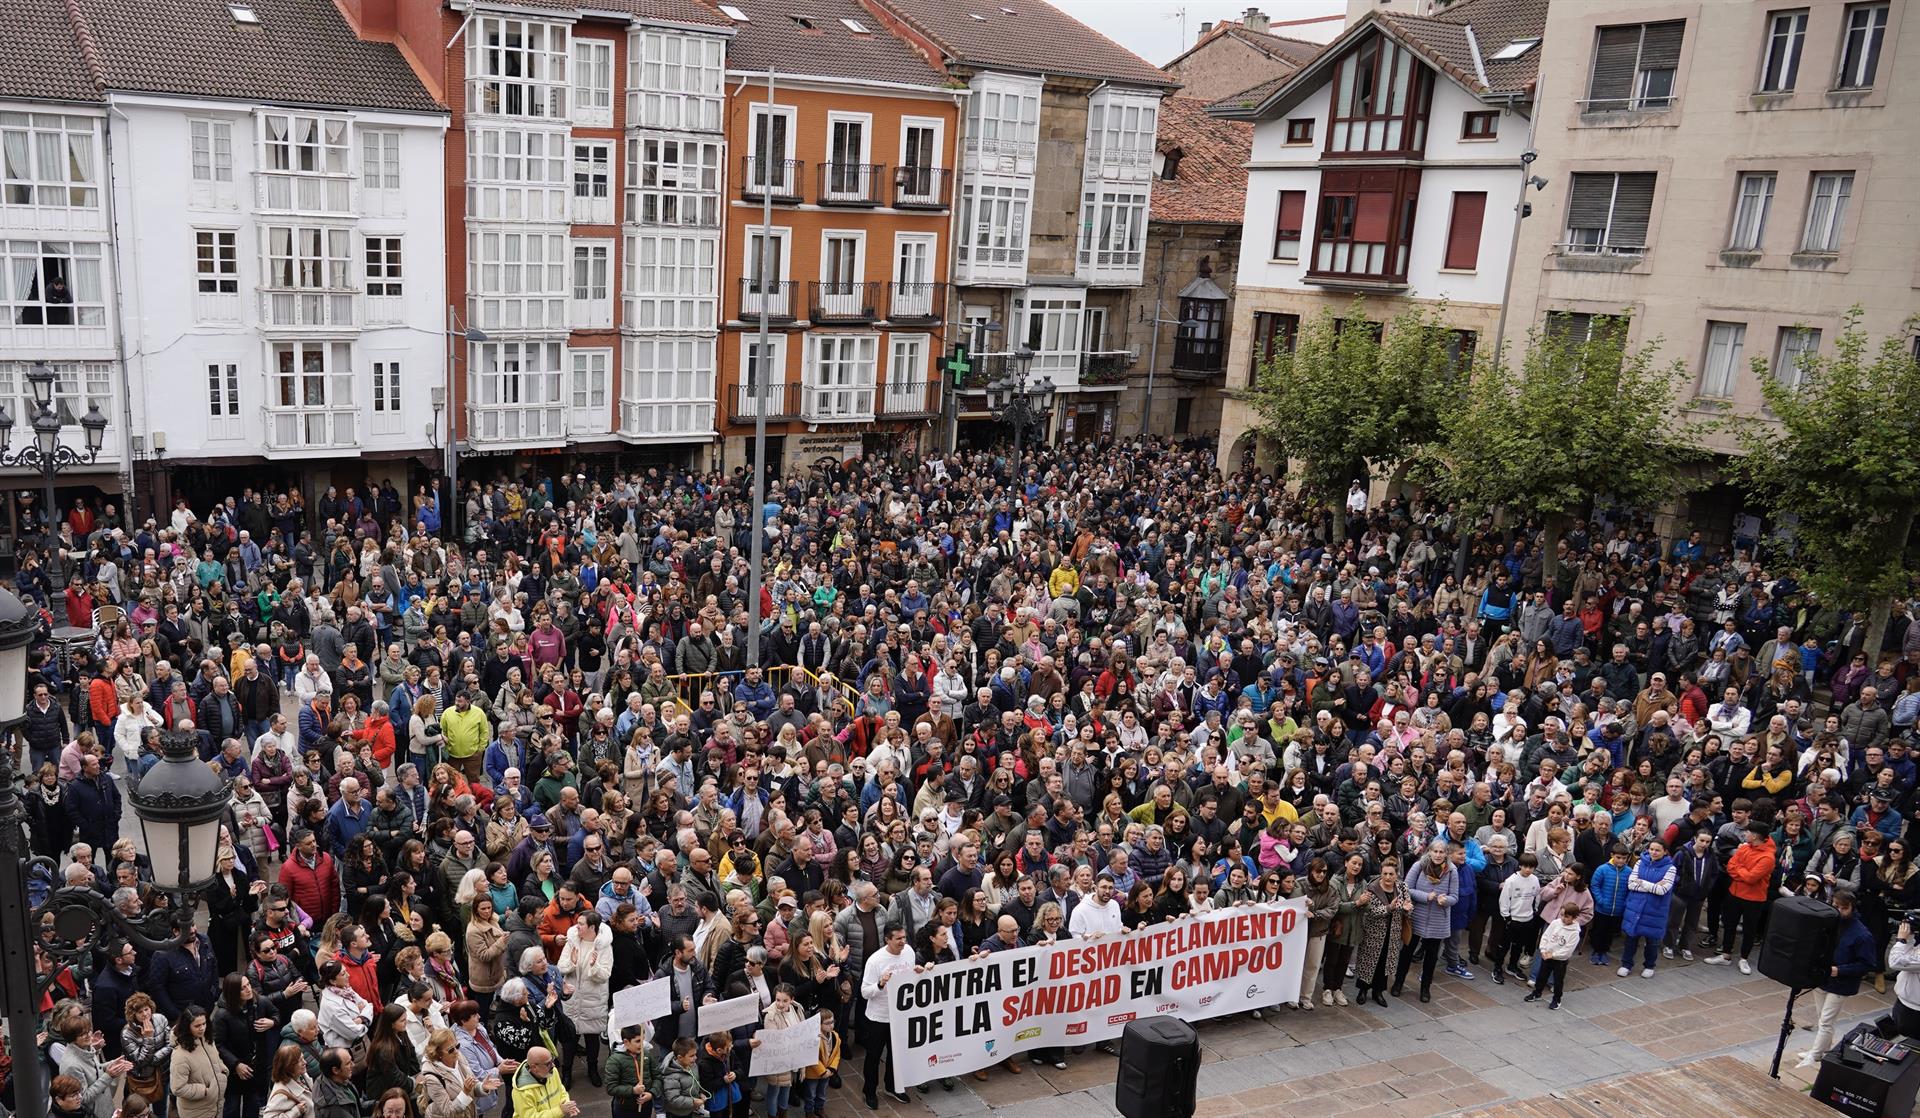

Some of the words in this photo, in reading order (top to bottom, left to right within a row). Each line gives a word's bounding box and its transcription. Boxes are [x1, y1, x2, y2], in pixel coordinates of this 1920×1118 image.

[896, 964, 1002, 1011] CONTRA
[1012, 957, 1038, 988] EL
[1049, 908, 1296, 980] DESMANTELAMIENTO
[908, 1010, 943, 1048] DE
[955, 1001, 992, 1037] LA
[1002, 974, 1121, 1027] SANIDAD
[1130, 966, 1163, 1000] EN
[1171, 941, 1282, 991] CAMPOO
[1109, 1015, 1128, 1023] CCOO
[1156, 1004, 1169, 1013] UGT
